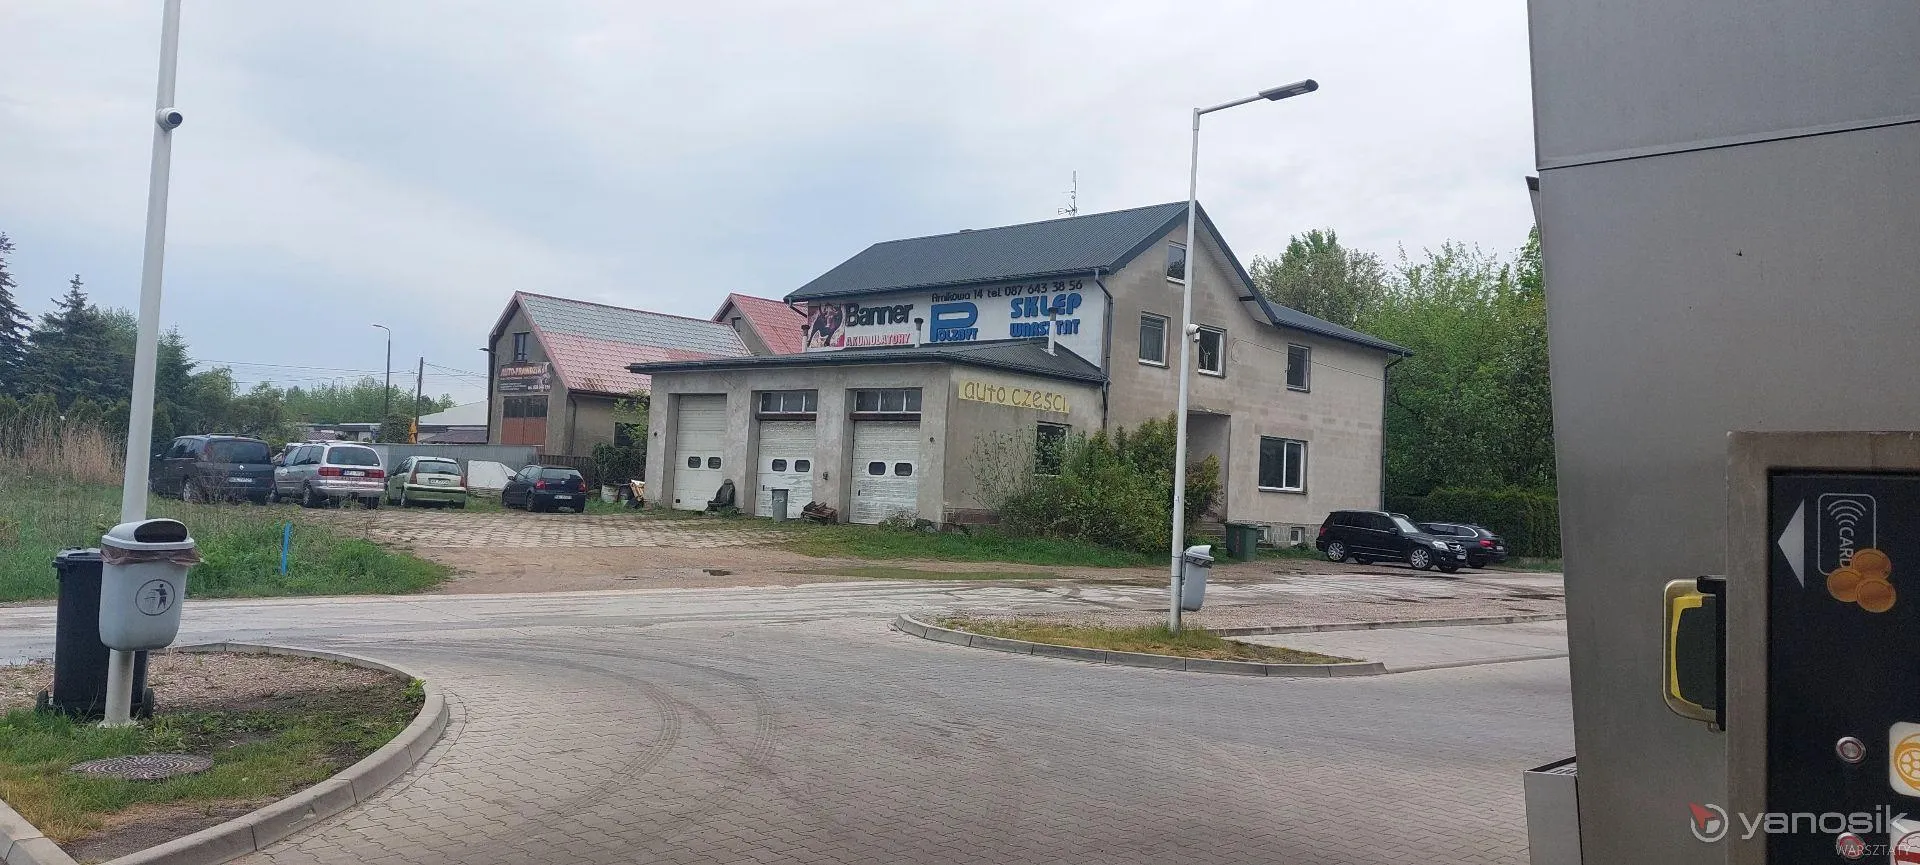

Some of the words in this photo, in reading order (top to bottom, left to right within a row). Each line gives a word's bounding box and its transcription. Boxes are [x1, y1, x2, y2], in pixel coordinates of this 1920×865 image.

[973, 288, 983, 299] 14
[1004, 285, 1023, 297] 087
[1027, 282, 1048, 294] 643
[1052, 281, 1066, 292] 38
[1069, 279, 1083, 291] 56
[844, 302, 914, 327] Banner
[1010, 292, 1082, 318] SKLEP
[845, 333, 911, 347] AKUMULATORY
[964, 381, 1006, 403] auto
[1839, 526, 1855, 569] CARD
